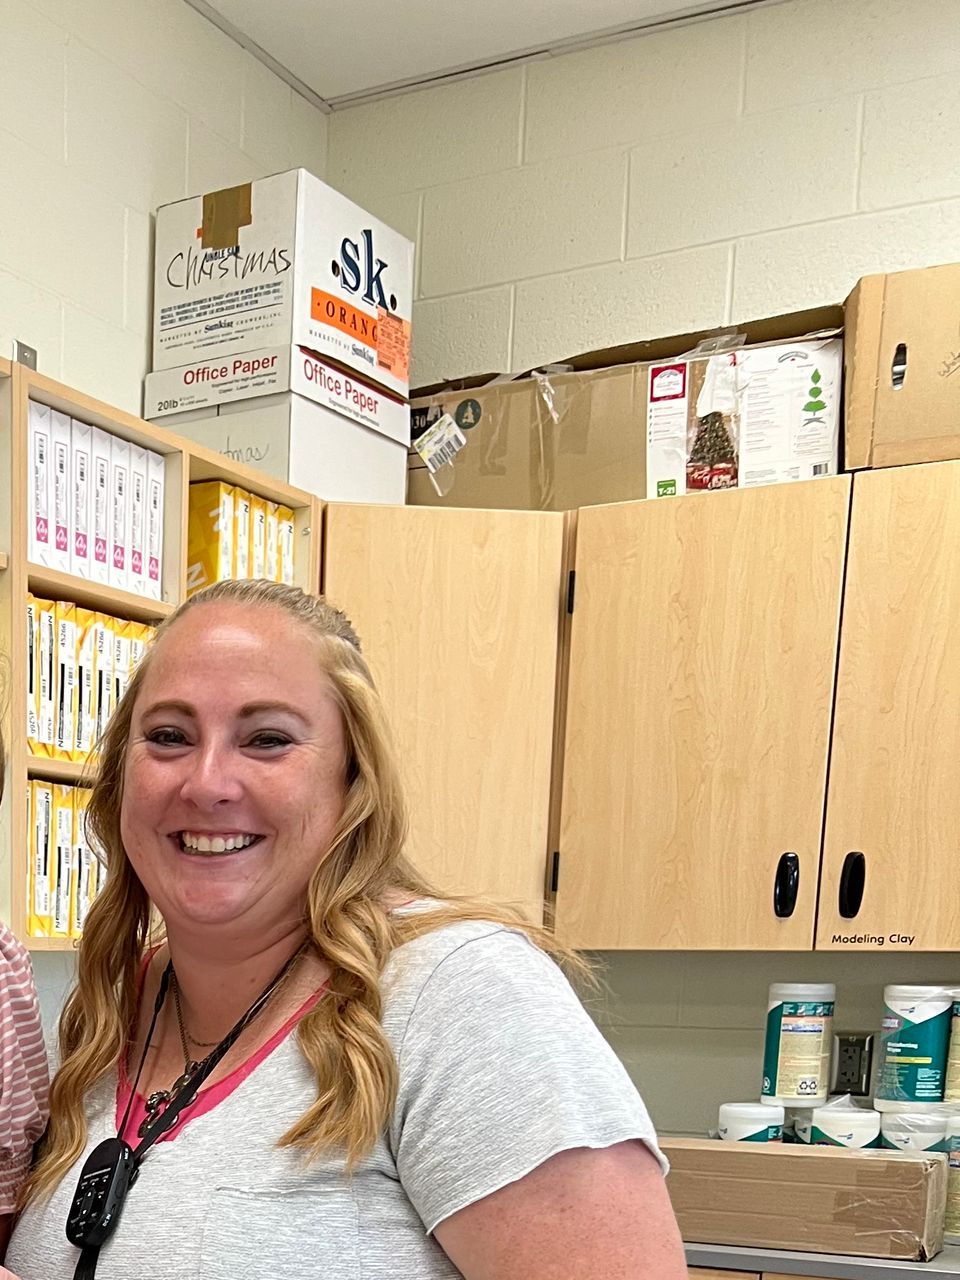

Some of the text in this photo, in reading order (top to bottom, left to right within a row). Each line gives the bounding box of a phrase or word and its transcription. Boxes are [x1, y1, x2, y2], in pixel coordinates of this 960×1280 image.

[183, 366, 229, 386] Office
[232, 355, 278, 375] Paper
[303, 359, 342, 396] Office
[344, 379, 380, 416] Paper
[157, 399, 178, 412] 20lb
[831, 933, 916, 946] Modeling Clay
